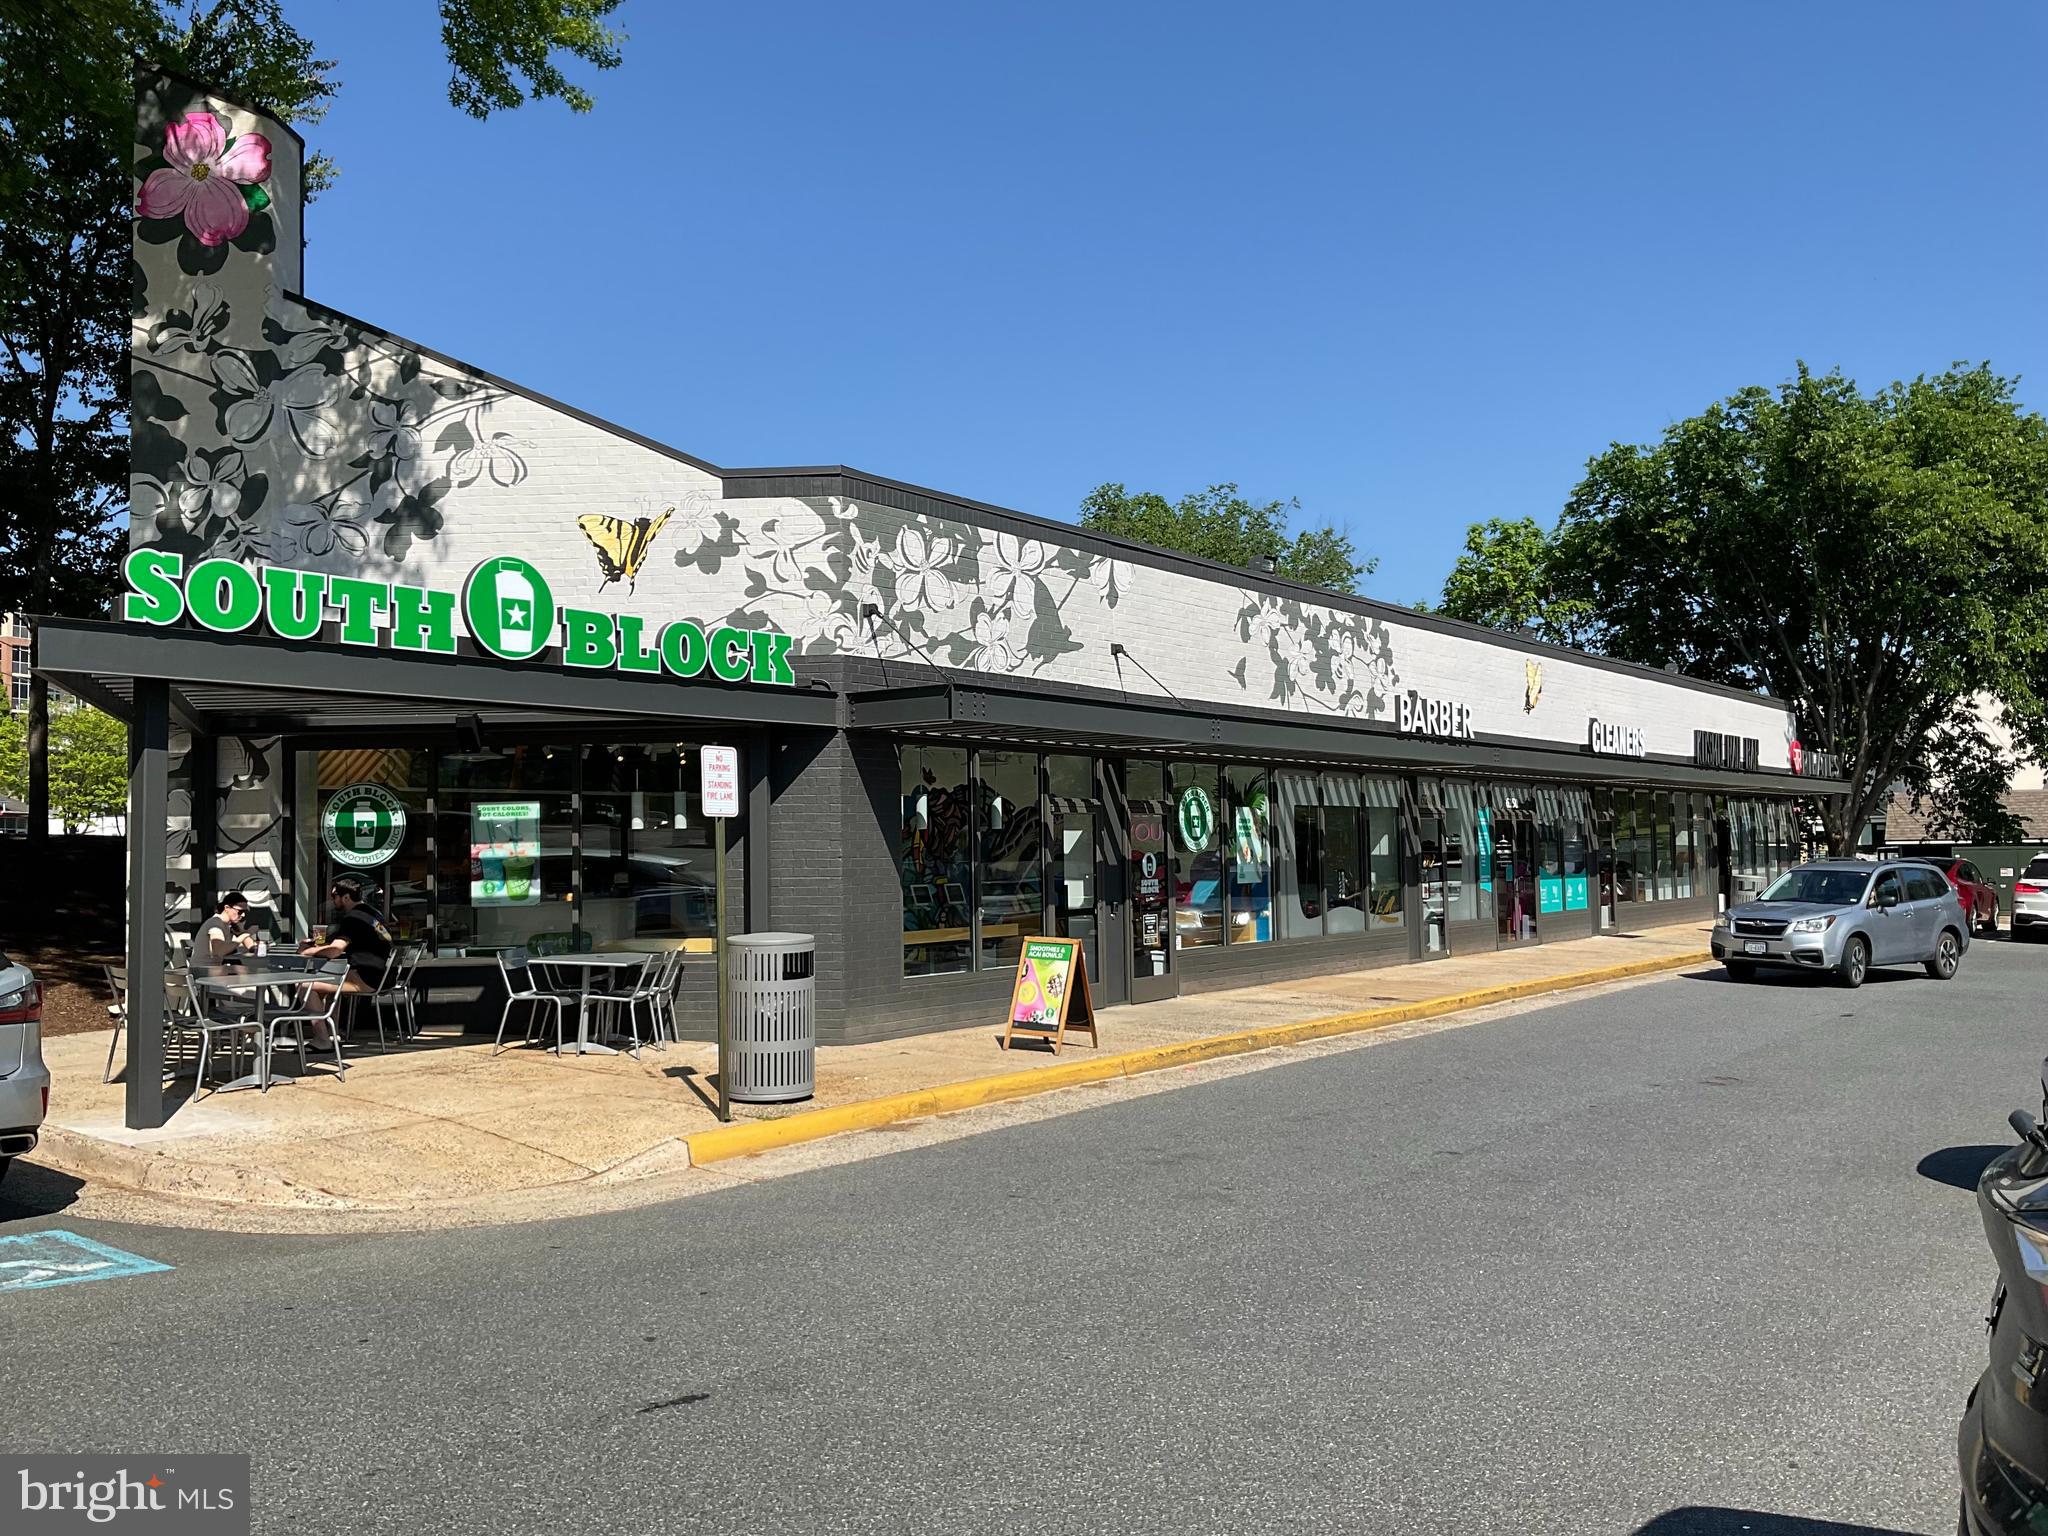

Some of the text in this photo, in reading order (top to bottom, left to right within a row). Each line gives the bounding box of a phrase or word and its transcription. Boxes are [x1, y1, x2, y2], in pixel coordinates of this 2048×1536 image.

[124, 548, 796, 687] SOUTH BLOCK
[1399, 694, 1475, 740] BARBER
[1591, 721, 1646, 758] CLEANERS
[708, 763, 731, 772] PARKING
[708, 781, 733, 789] STANDING
[328, 787, 399, 817] SOUTH BLOCK
[707, 792, 733, 800] FIRE LANE
[338, 846, 386, 863] SMOOTHIES
[1030, 944, 1060, 953] SMOOTHIES
